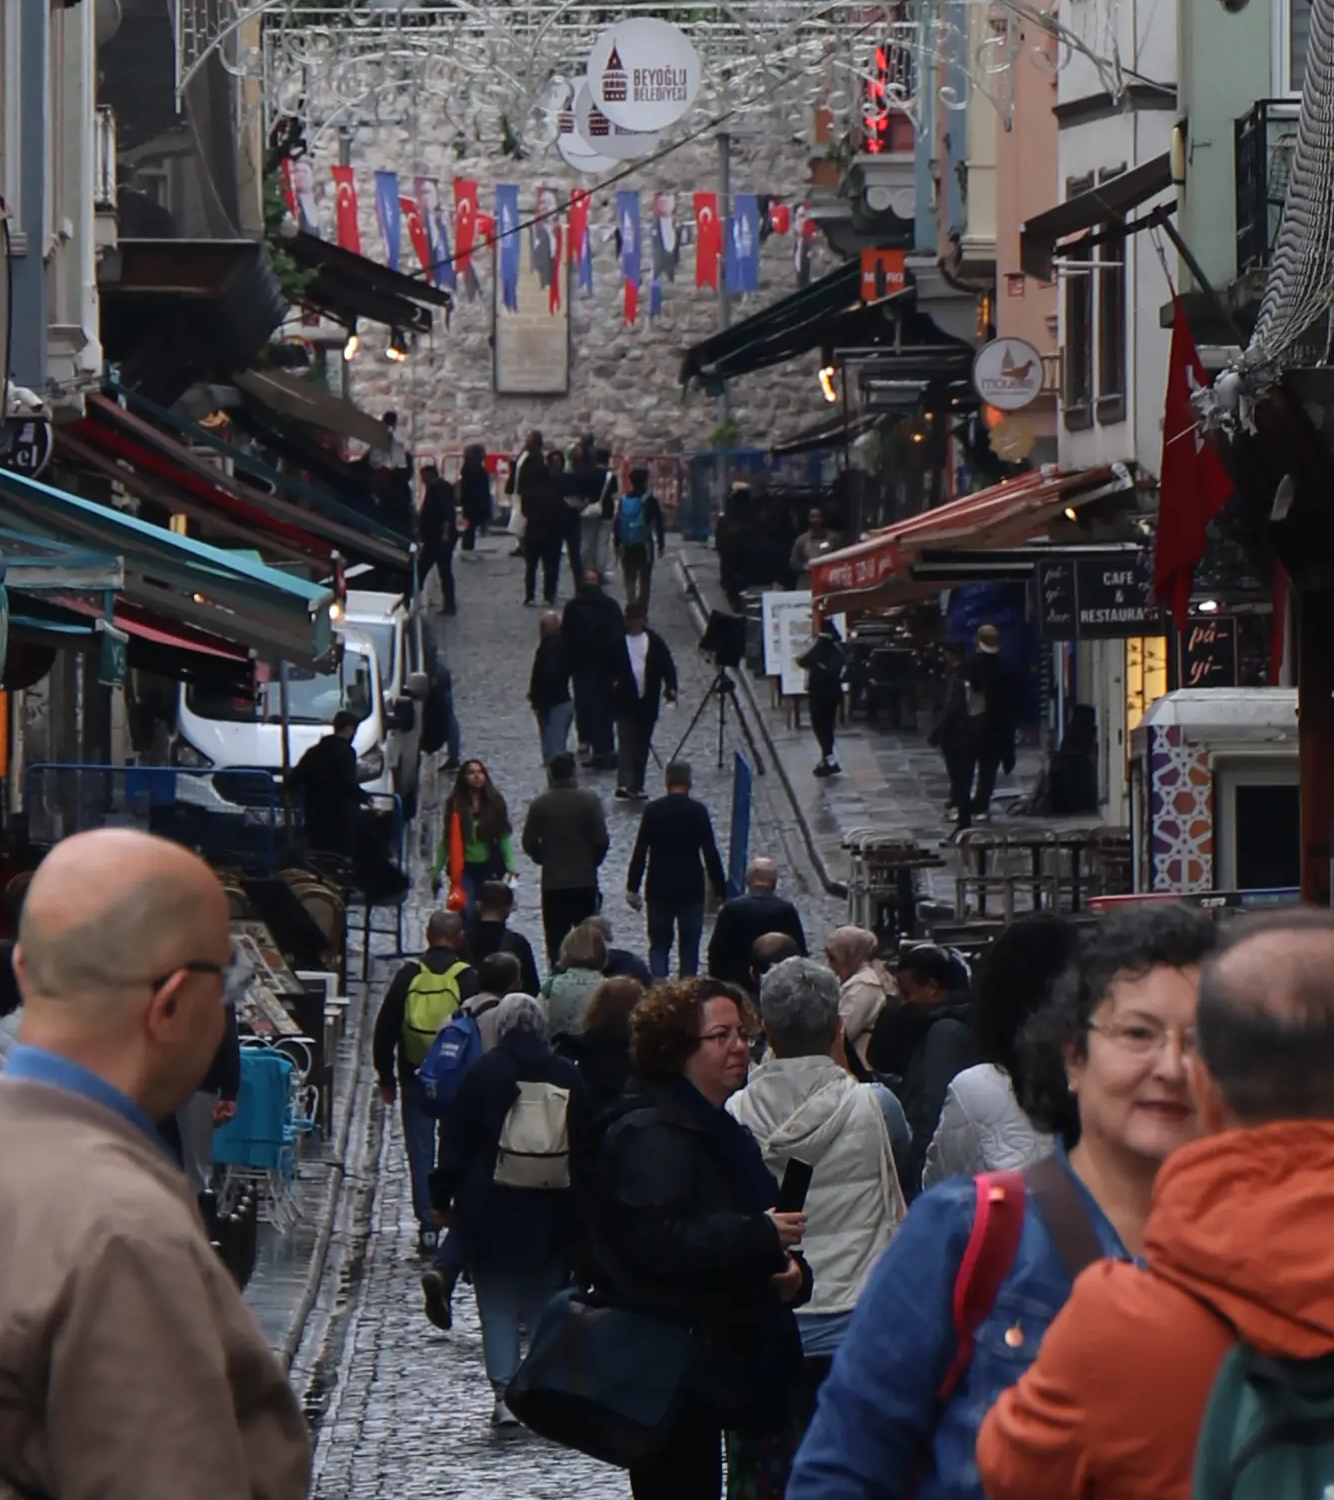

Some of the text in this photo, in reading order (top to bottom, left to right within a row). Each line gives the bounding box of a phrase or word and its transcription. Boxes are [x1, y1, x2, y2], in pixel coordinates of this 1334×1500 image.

[633, 64, 687, 86] BEYOĞLU
[1103, 571, 1134, 586] CAFE
[1114, 589, 1124, 603] &
